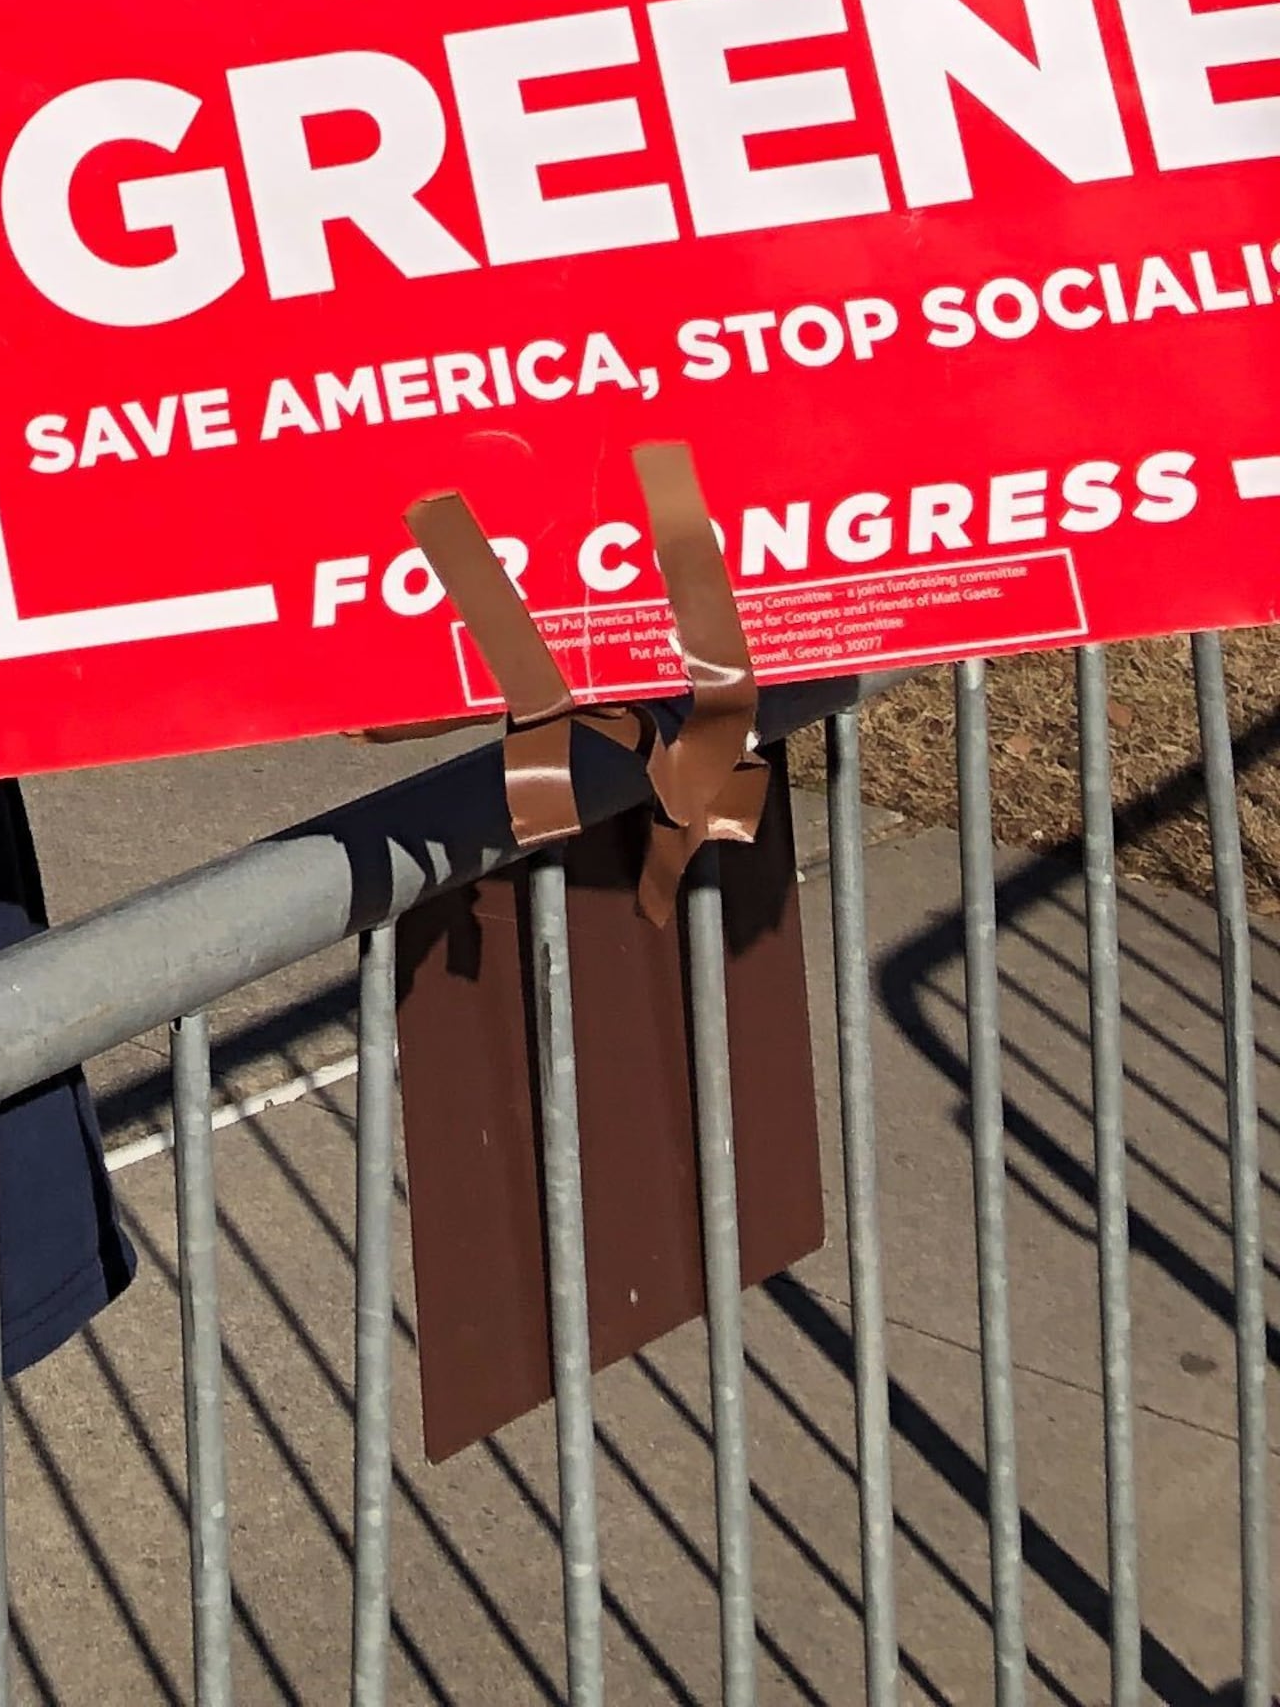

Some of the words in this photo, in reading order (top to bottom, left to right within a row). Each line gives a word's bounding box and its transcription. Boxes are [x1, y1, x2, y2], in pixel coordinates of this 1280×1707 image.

[26, 388, 238, 474] SAVE
[262, 332, 658, 440] AMERICA,
[678, 299, 899, 380] STOP
[577, 451, 1198, 592] CNGRESS
[544, 618, 561, 634] by
[562, 616, 583, 631] Put
[583, 611, 633, 629] America
[635, 608, 662, 625] First
[764, 590, 833, 610] Committee
[847, 588, 855, 599] a
[856, 581, 886, 600] joint
[887, 571, 958, 592] fundraising
[959, 565, 1028, 584] committee
[593, 630, 608, 646] of
[609, 629, 632, 645] and
[764, 612, 784, 628] for
[784, 606, 842, 626] Congress
[843, 601, 868, 618] and
[869, 596, 915, 614] Friends
[916, 592, 931, 609] of
[931, 590, 963, 606] Matt
[630, 646, 653, 661] Put
[761, 624, 834, 646] Fundraising
[835, 616, 905, 637] Committee
[750, 649, 793, 666] oswell,
[794, 641, 844, 661] Georgia
[845, 635, 883, 653] 30077
